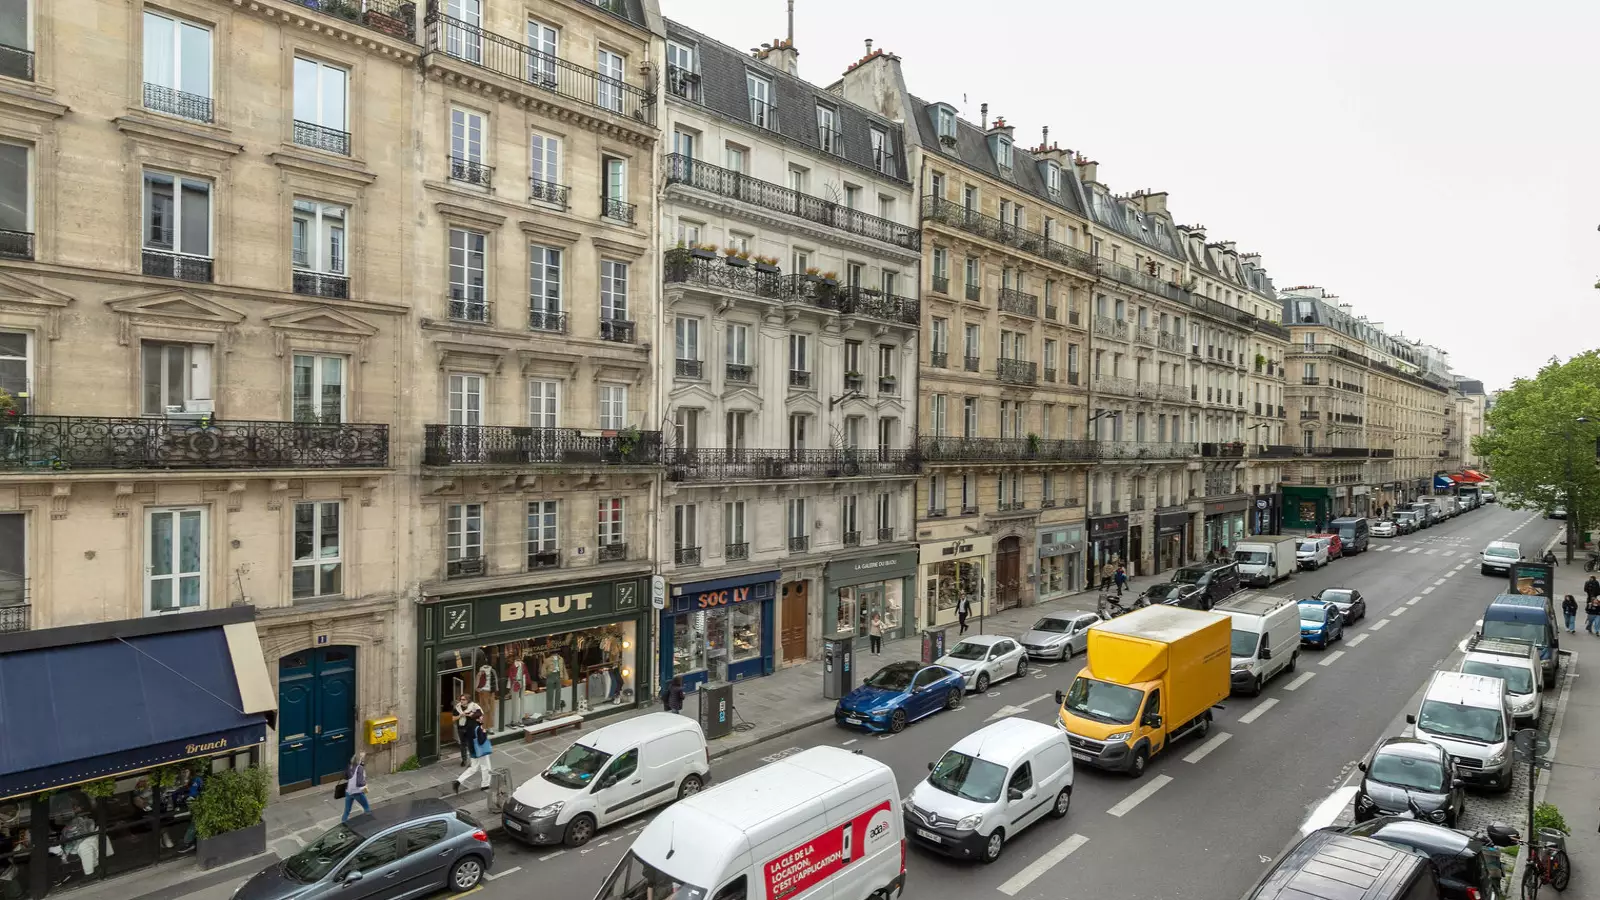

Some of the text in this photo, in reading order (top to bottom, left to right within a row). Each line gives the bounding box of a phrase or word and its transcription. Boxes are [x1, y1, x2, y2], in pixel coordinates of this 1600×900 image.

[699, 587, 750, 609] SOC LY
[185, 738, 227, 754] Brunch
[870, 824, 882, 838] ada
[770, 844, 815, 873] LA CLÉ DE LA
[771, 858, 811, 884] LOCATION,
[772, 877, 792, 894] C'EST
